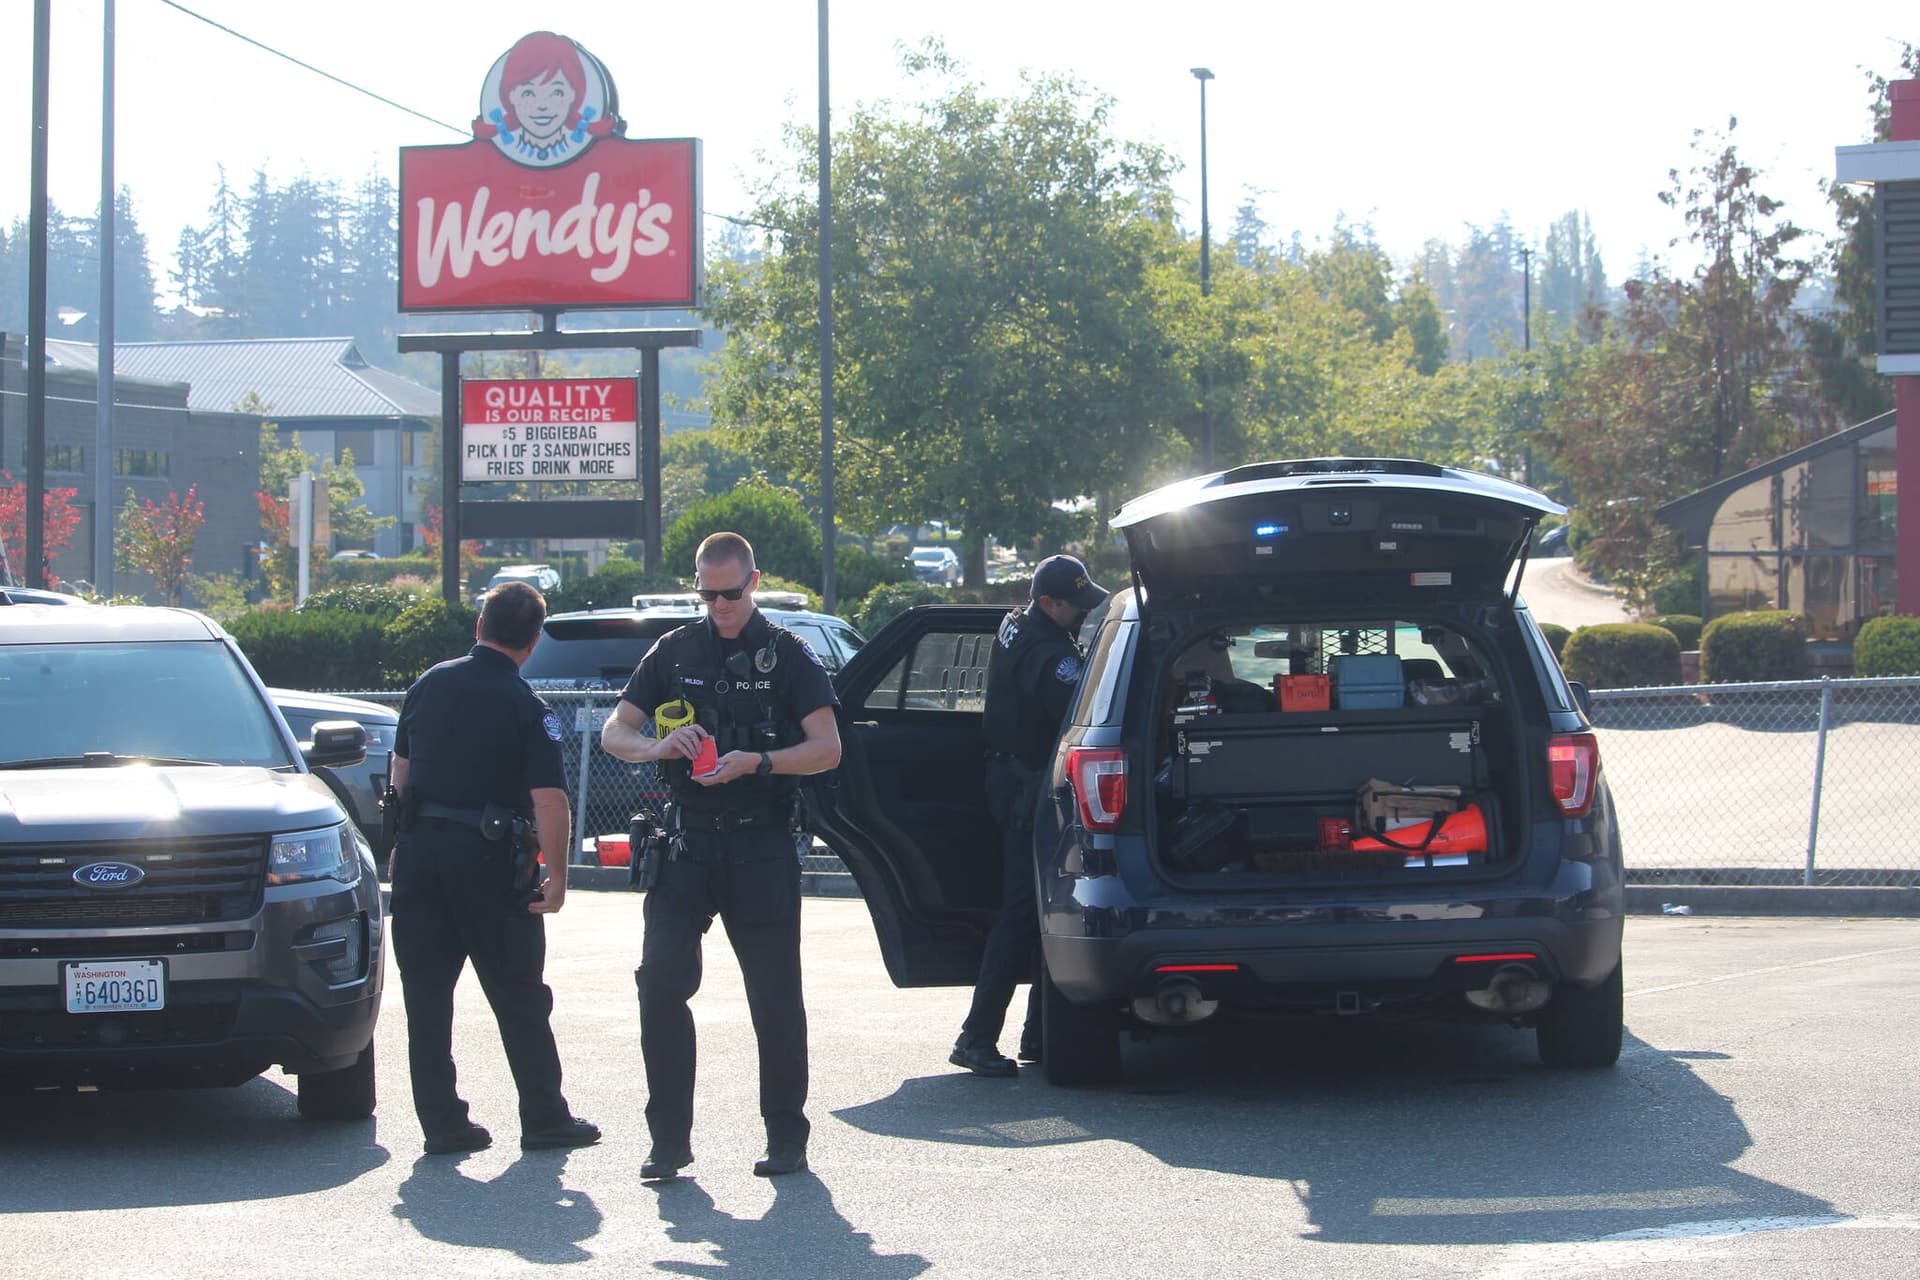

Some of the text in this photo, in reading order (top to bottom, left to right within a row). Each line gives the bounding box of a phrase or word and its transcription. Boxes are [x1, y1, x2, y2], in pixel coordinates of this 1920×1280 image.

[417, 171, 673, 288] Wendy's
[485, 384, 612, 408] QUALITY
[486, 408, 612, 422] IS OUR RECIPE
[502, 425, 597, 441] $5 BIGGIEBAG
[467, 444, 497, 459] PICK
[512, 444, 527, 457] OF
[532, 444, 540, 457] 3
[544, 442, 631, 457] SANDWICHES
[487, 460, 615, 475] FRIES DRINK MORE
[736, 681, 771, 690] POICE
[90, 865, 128, 883] Ford
[74, 970, 126, 979] WASHINGTON
[85, 979, 158, 1005] 64036D
